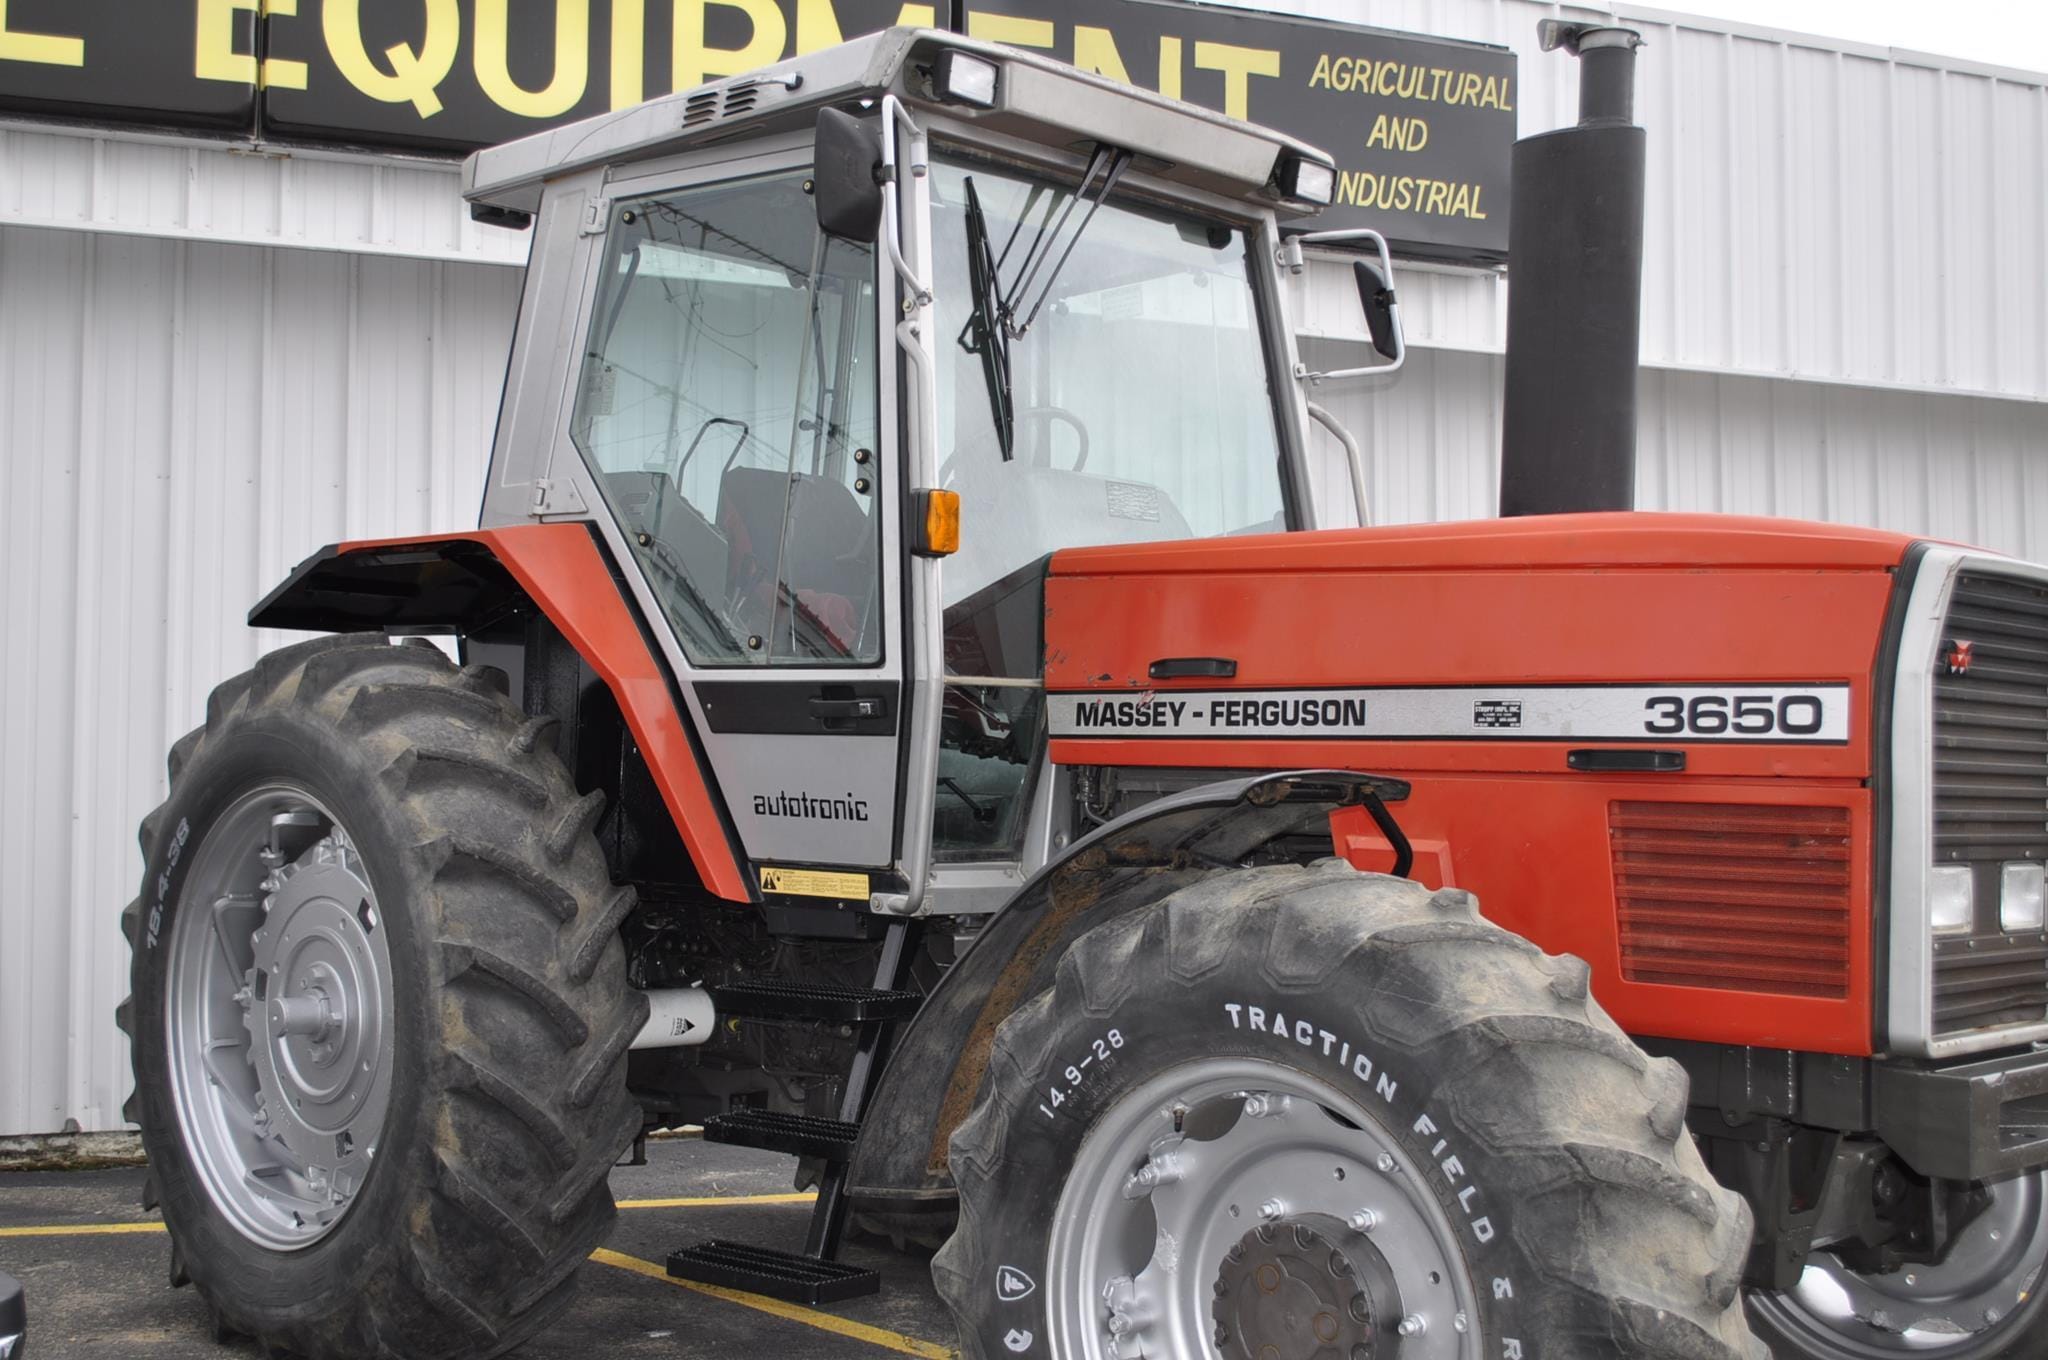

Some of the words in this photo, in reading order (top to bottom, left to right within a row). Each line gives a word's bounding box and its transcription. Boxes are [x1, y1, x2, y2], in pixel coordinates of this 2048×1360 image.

[196, 0, 1280, 121] EQUIPT
[1308, 54, 1512, 111] AGRICULTURAL
[1366, 114, 1428, 151] AND
[1337, 170, 1487, 220] NDUSTRIAL
[1644, 695, 1823, 735] 3650
[754, 790, 869, 821] autotronic
[147, 817, 190, 949] 18.4-38
[1040, 1028, 1124, 1119] 14.9-28
[1225, 1003, 1397, 1103] TRACTION
[1413, 1113, 1494, 1243] FIELD
